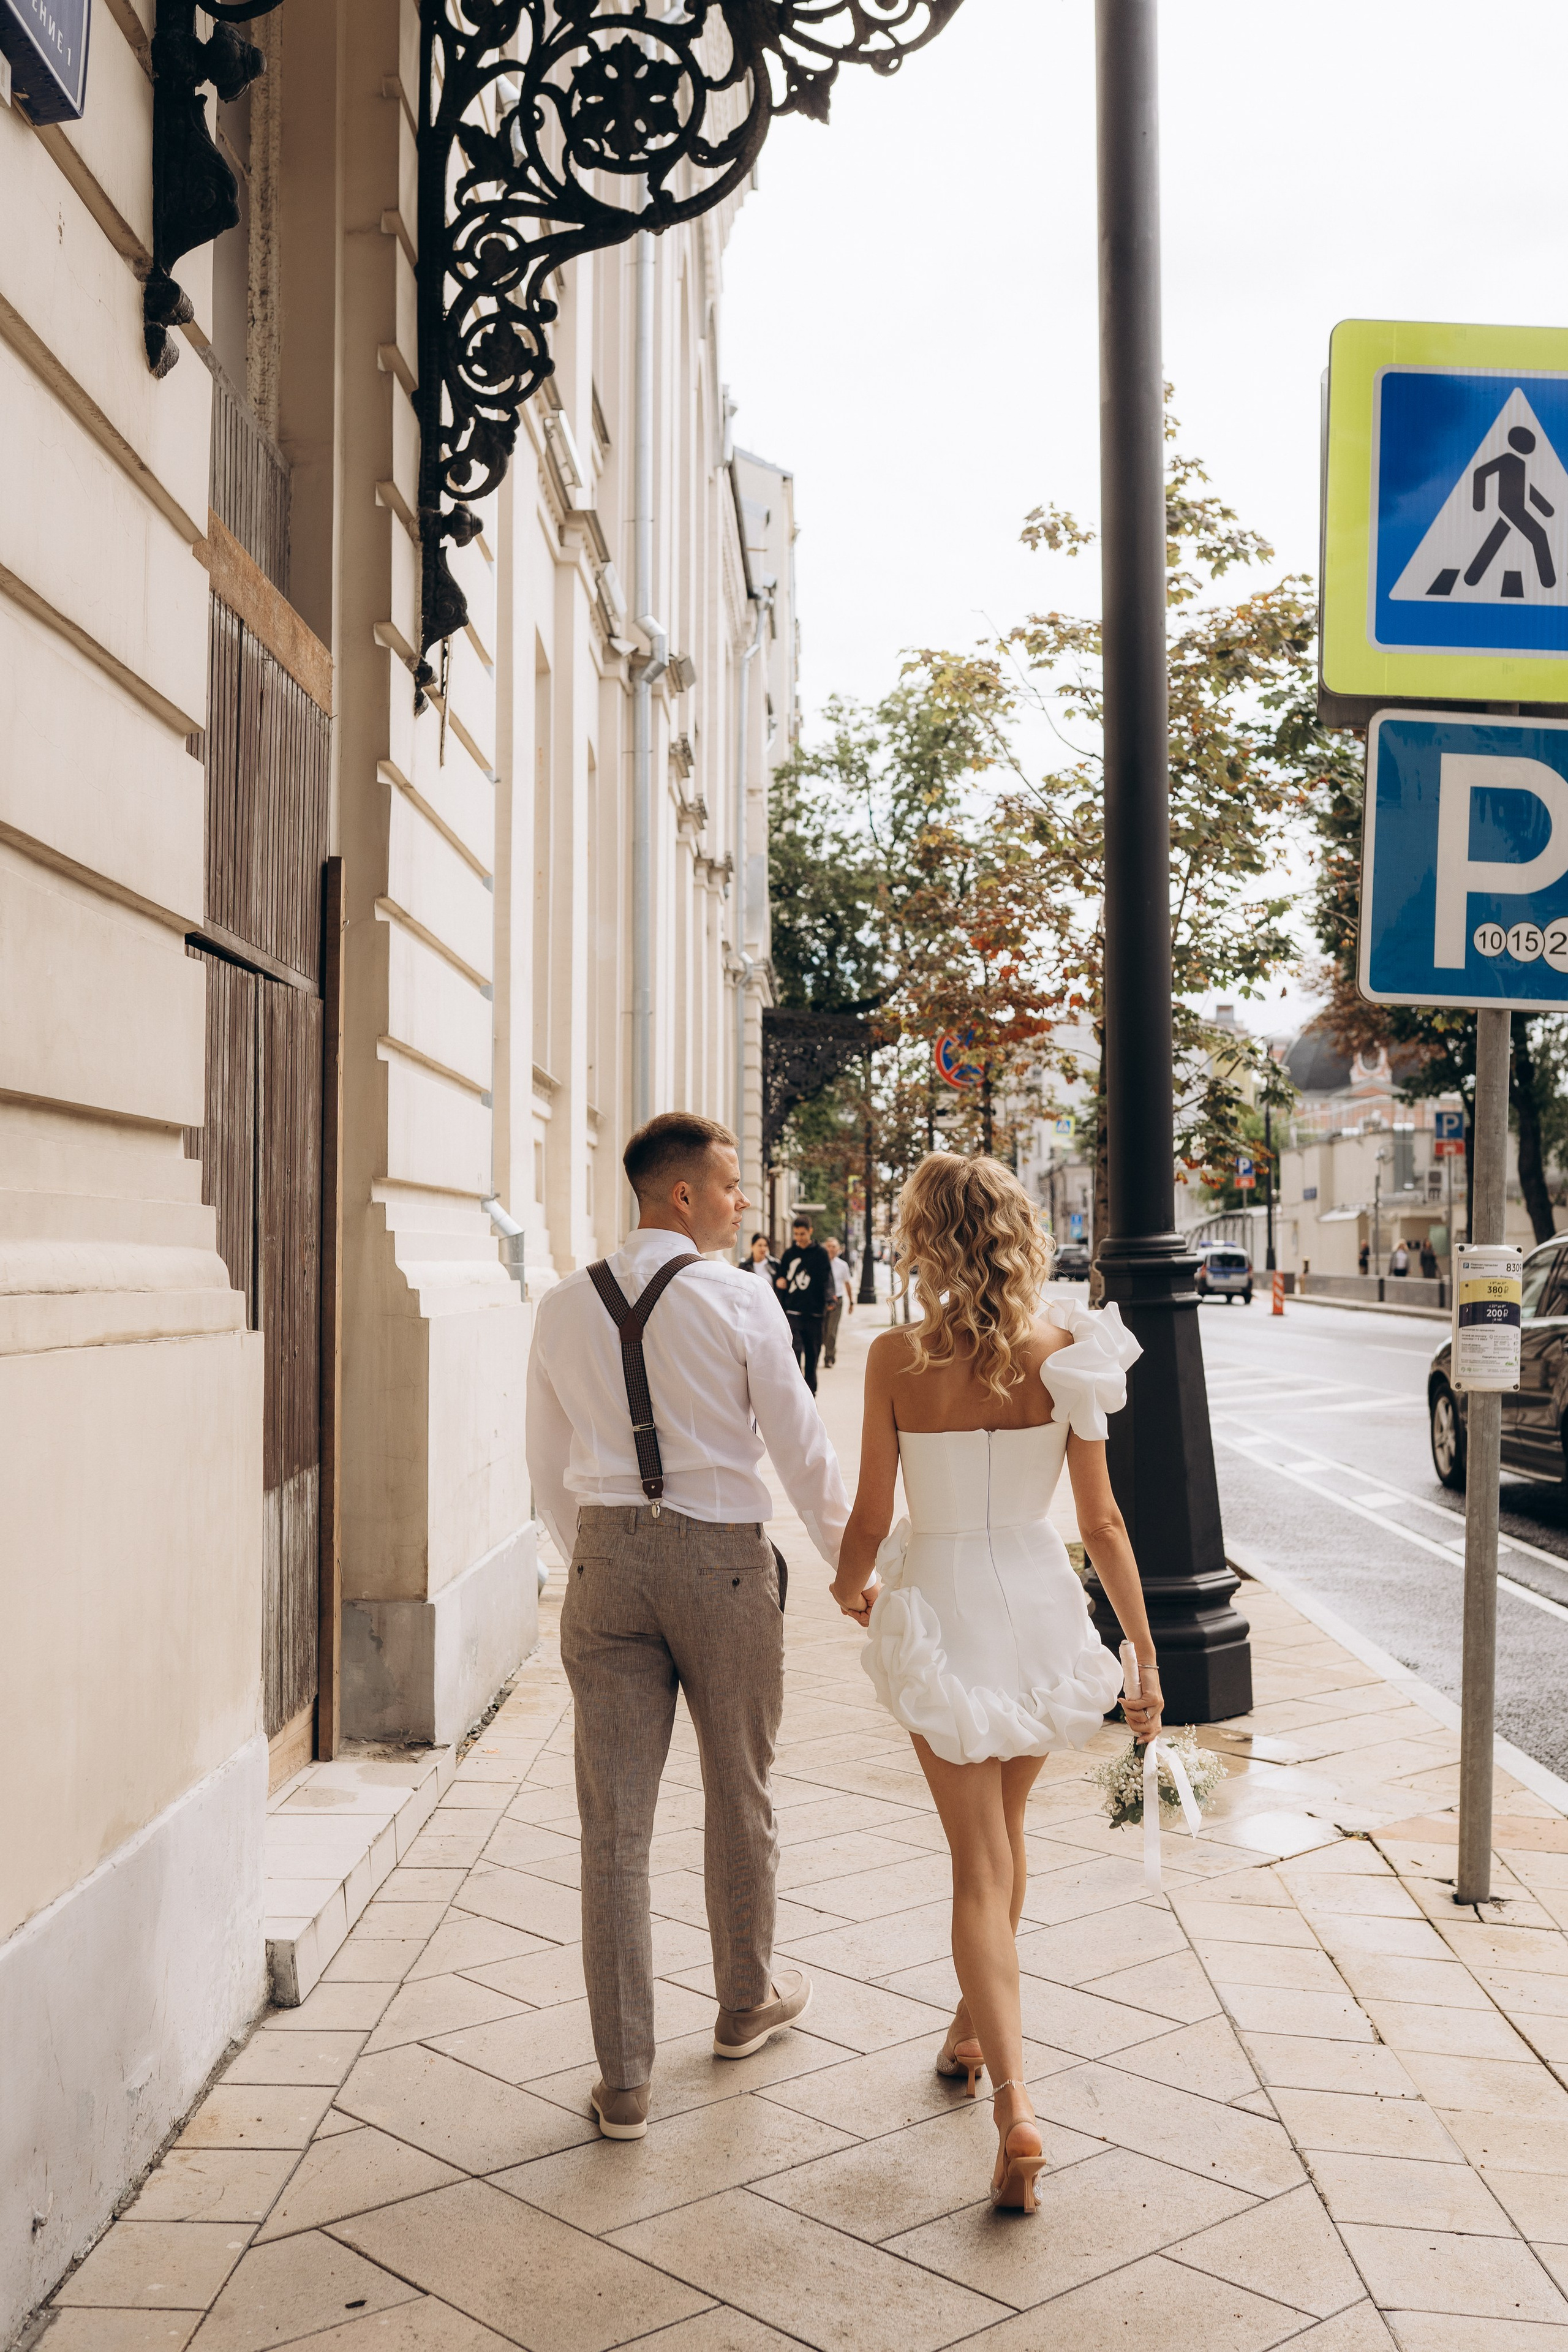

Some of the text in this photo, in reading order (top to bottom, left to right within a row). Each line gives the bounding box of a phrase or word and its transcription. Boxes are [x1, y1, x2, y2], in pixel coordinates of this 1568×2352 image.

[67, 47, 71, 67] 1
[1434, 752, 1568, 969] P
[1479, 930, 1502, 950] 10
[1512, 930, 1539, 952] 15
[1442, 1115, 1460, 1137] P
[1238, 1157, 1250, 1175] P
